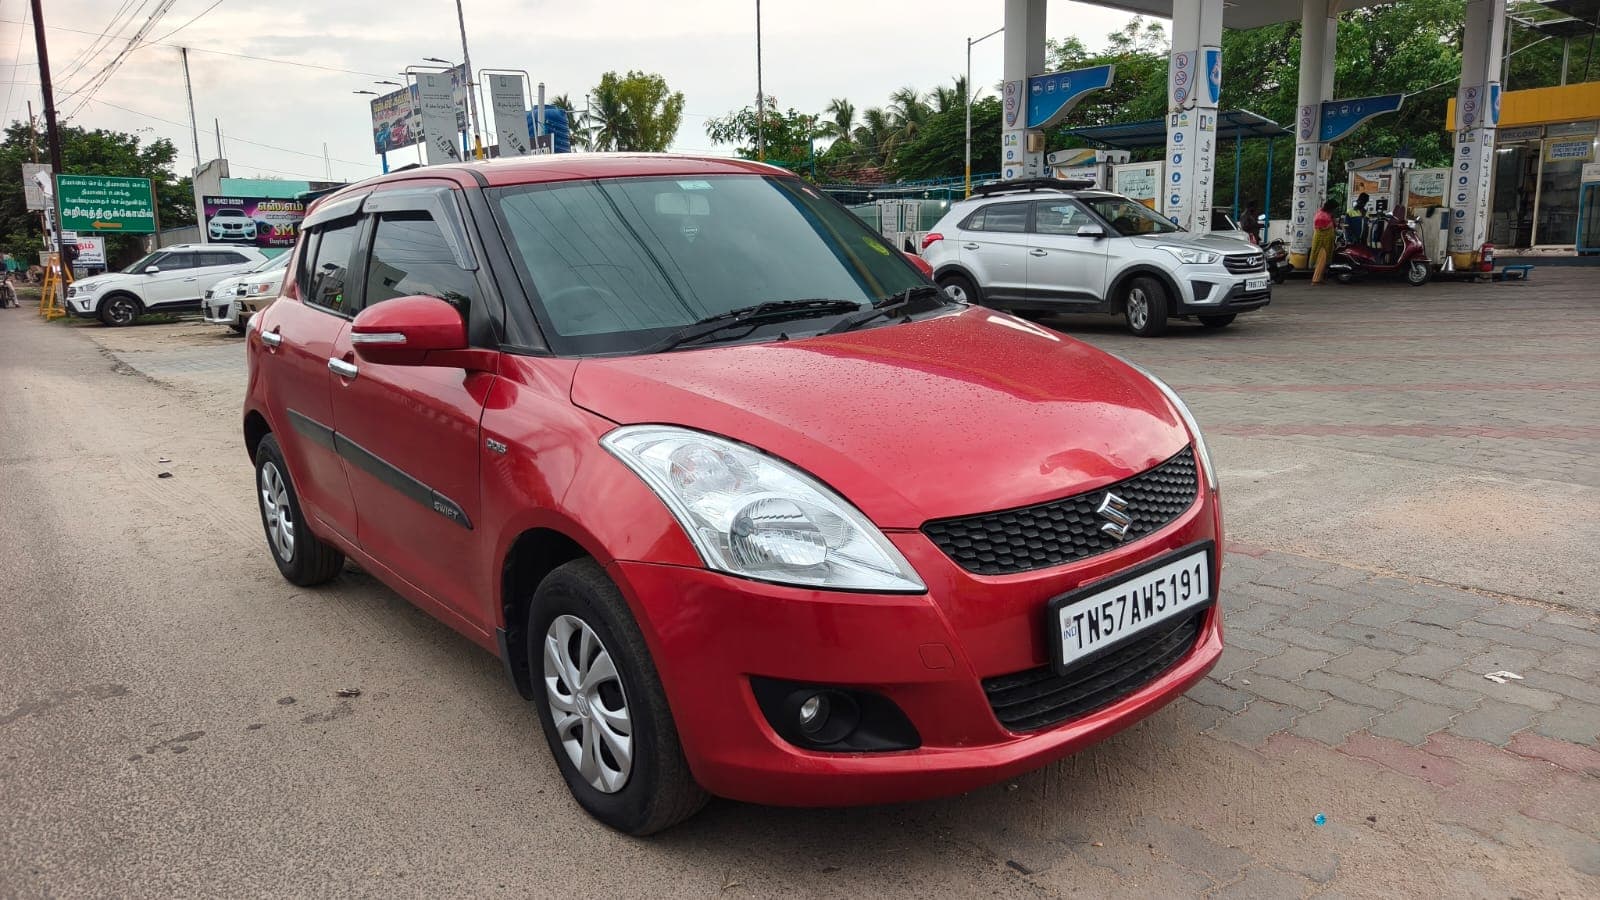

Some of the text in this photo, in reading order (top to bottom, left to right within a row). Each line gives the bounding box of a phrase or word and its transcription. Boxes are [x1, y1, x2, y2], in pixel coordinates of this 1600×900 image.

[63, 206, 153, 220] அறிவுத்திருக்கோயில்
[274, 223, 294, 236] SM
[433, 501, 459, 520] SWIFT
[1073, 563, 1203, 649] TN57AW5191
[1063, 627, 1077, 641] IND
